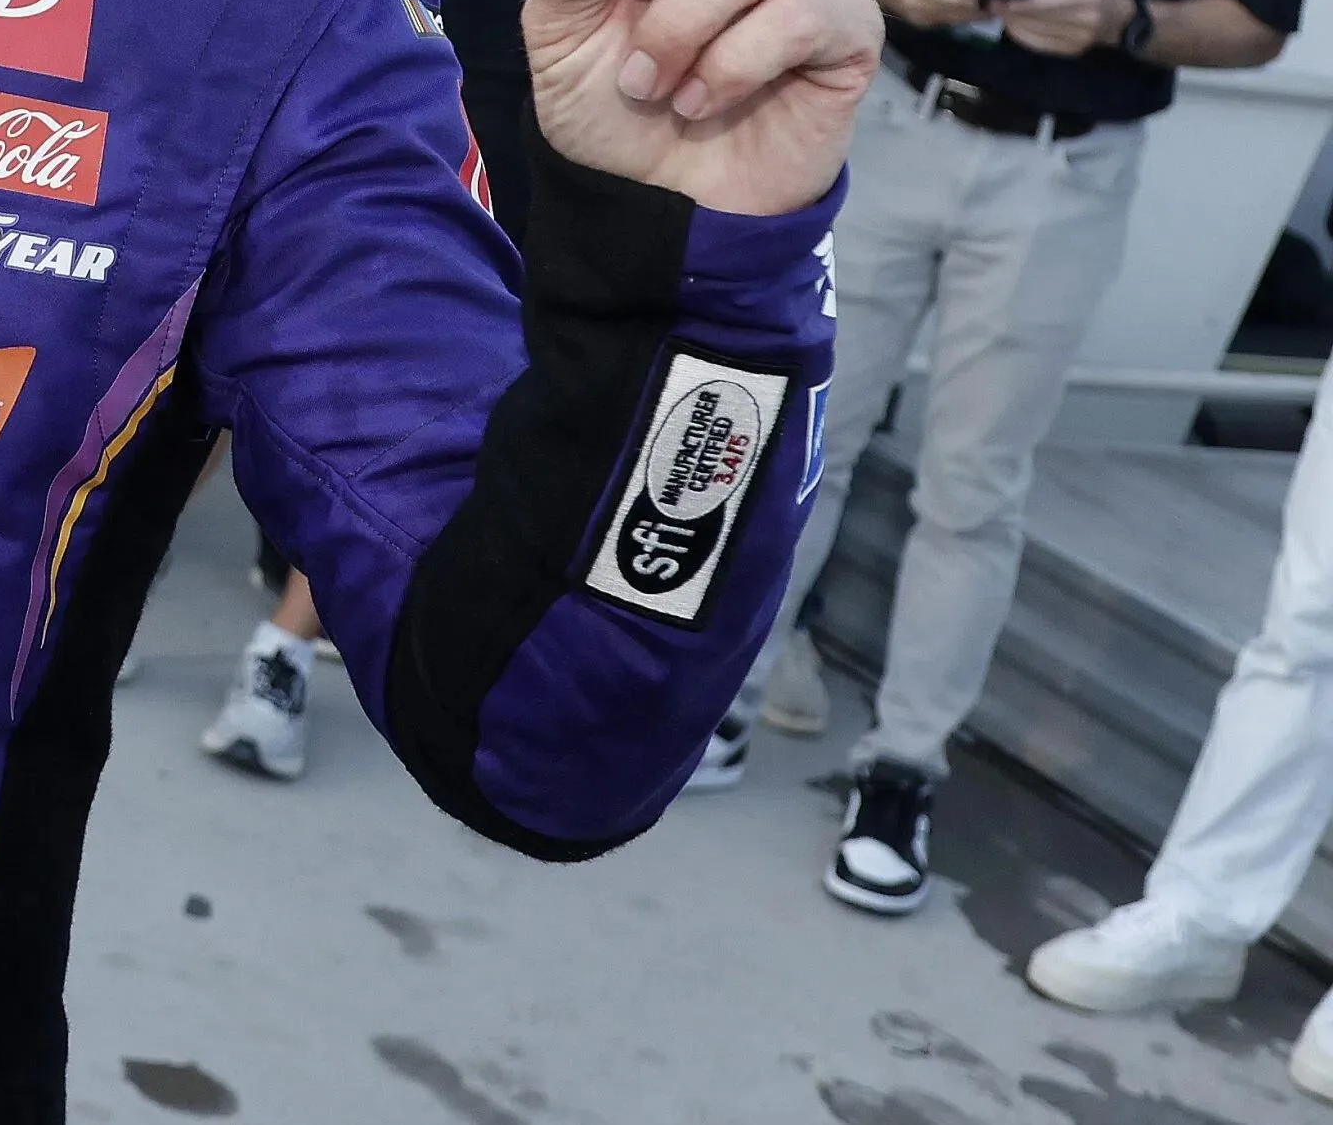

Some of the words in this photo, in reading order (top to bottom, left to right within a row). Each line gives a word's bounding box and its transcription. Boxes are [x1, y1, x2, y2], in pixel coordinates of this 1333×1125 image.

[658, 391, 721, 507] MANUFACTURER
[688, 416, 734, 493] CERTIFIED
[632, 520, 696, 581] sfi
